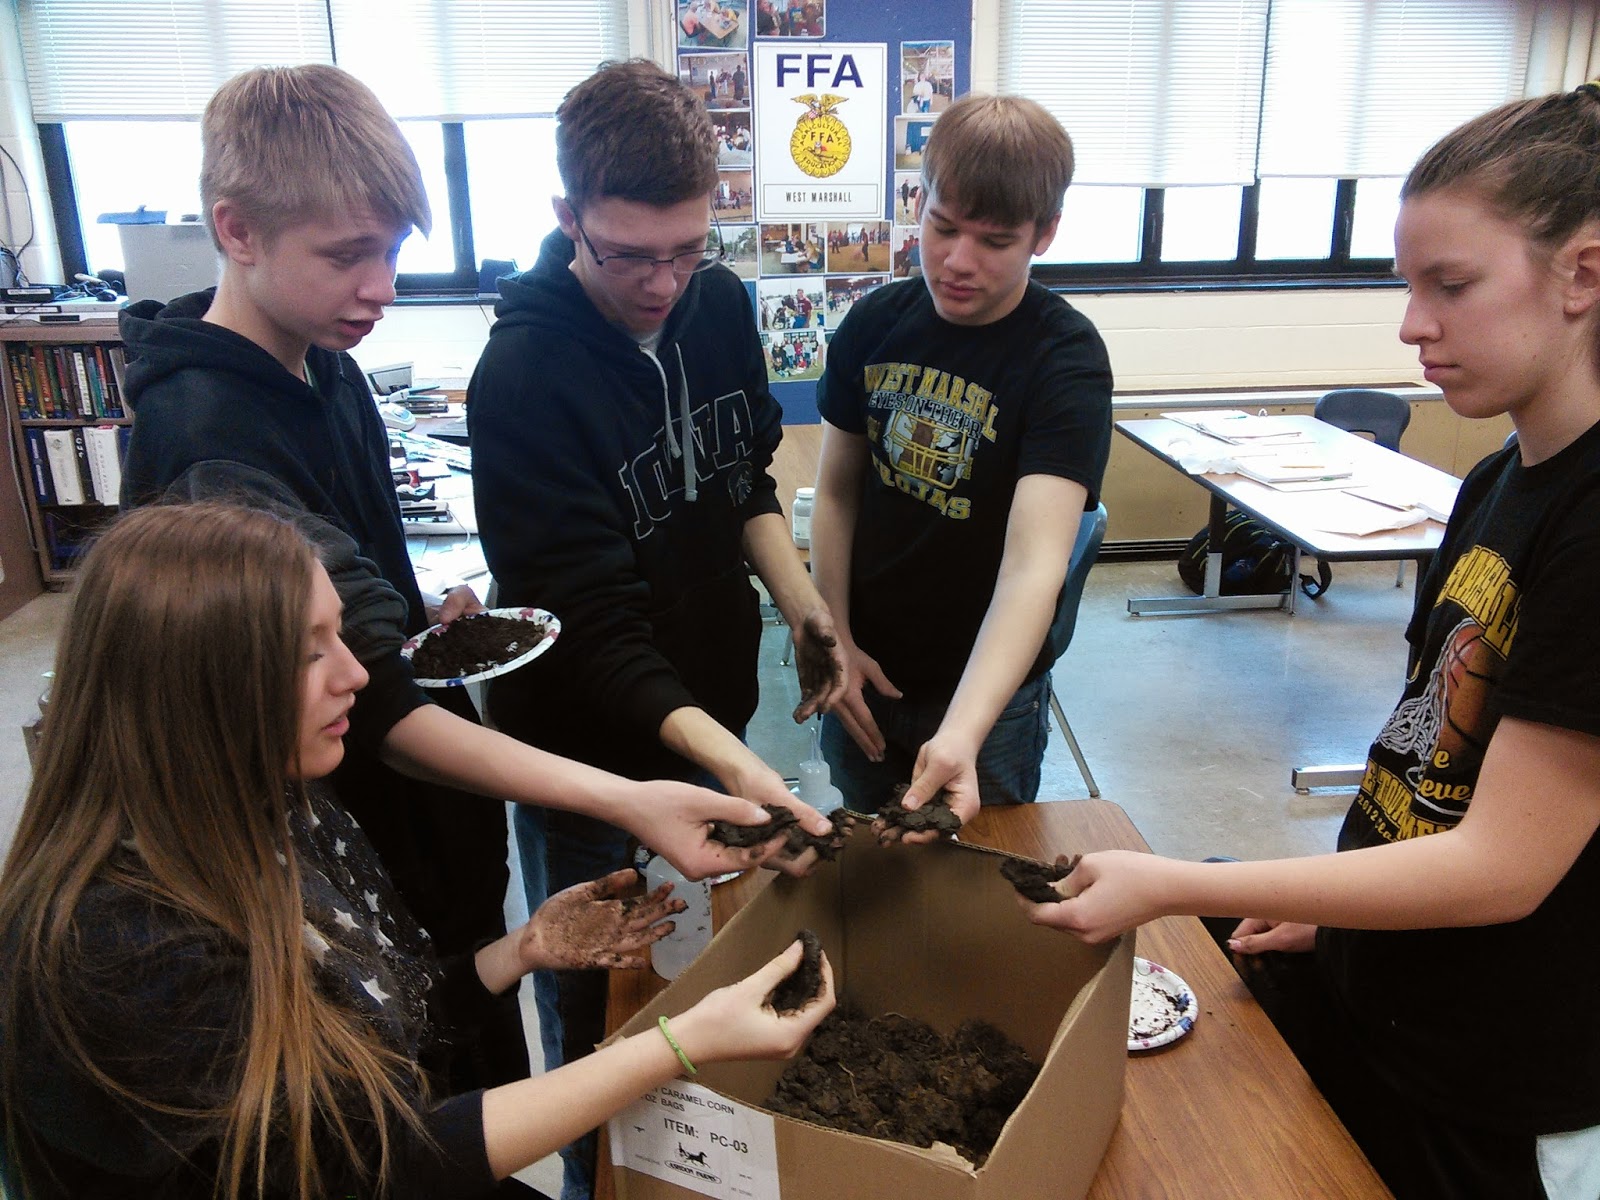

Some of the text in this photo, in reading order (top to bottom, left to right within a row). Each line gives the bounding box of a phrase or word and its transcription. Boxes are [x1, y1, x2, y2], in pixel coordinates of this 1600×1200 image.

[776, 53, 864, 88] FFA
[799, 122, 843, 146] AGRICULTURAL
[810, 131, 834, 143] FFA
[802, 155, 839, 169] EDUCATION
[785, 191, 853, 203] WEST MARSHALL
[863, 361, 922, 395] WEST
[868, 390, 907, 411] EYES
[904, 394, 926, 416] ON
[927, 400, 964, 430] THE
[1357, 793, 1379, 822] 2012
[660, 1098, 685, 1112] BAGS
[661, 1087, 735, 1115] CARAMEL CORN
[663, 1117, 749, 1155] ITEM: PC-03
